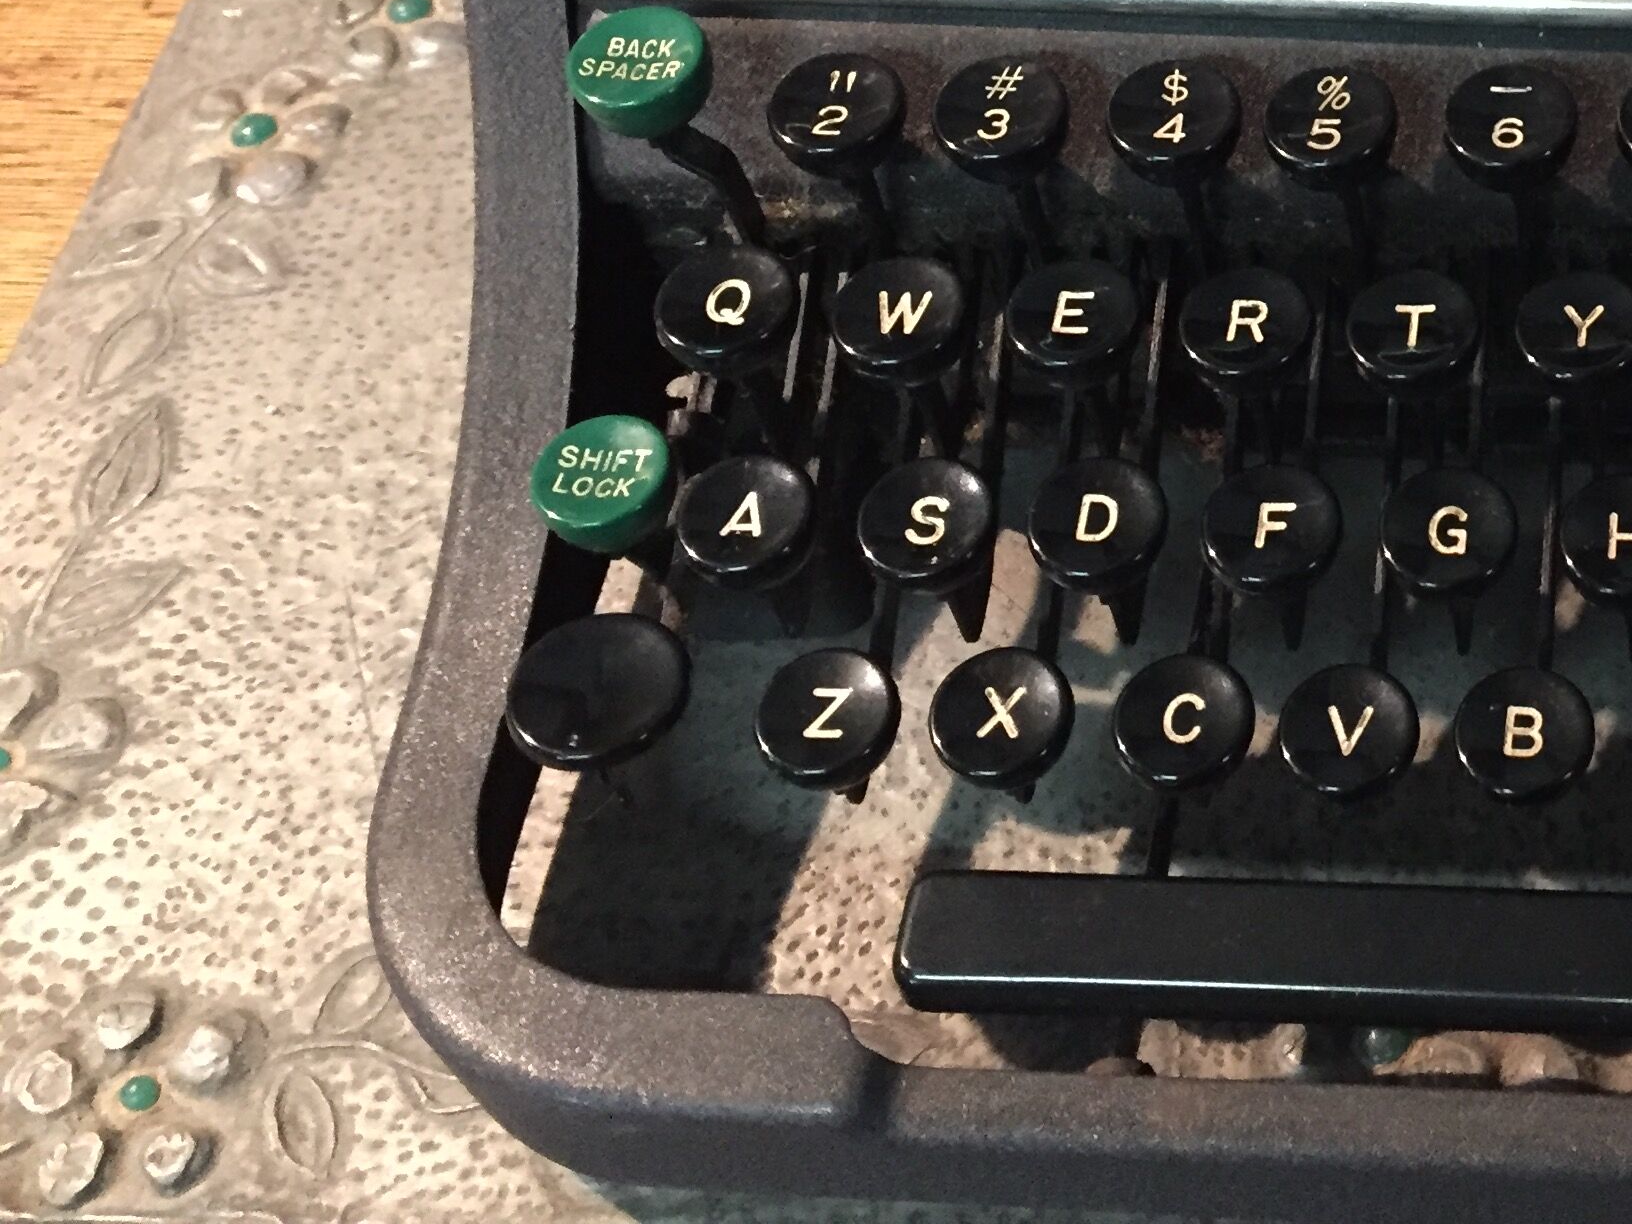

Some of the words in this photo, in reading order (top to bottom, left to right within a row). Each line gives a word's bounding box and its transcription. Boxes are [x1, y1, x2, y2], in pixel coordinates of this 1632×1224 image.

[578, 58, 686, 81] SPACER
[606, 36, 677, 60] BACK
[984, 65, 1024, 100] #
[1161, 68, 1189, 106] $
[1316, 75, 1351, 111] %
[811, 105, 849, 136] 2
[976, 108, 1011, 140] 3
[1152, 112, 1186, 144] 4
[1306, 118, 1342, 150] 5
[1491, 117, 1524, 149] 6
[705, 278, 752, 326] Q
[878, 290, 933, 335] W
[1051, 290, 1095, 335] E
[1226, 299, 1269, 343] R
[1394, 303, 1437, 348] T
[1563, 304, 1605, 348] Y
[557, 444, 654, 473] SHIFT
[551, 474, 636, 498] LOCK
[719, 490, 762, 538] A
[904, 495, 951, 545] S
[1075, 493, 1119, 542] D
[1254, 502, 1298, 549] F
[1428, 505, 1468, 555] G
[802, 686, 853, 739] Z
[976, 684, 1028, 739] X
[1163, 692, 1206, 744] C
[1327, 704, 1374, 757] V
[1503, 705, 1543, 757] B
